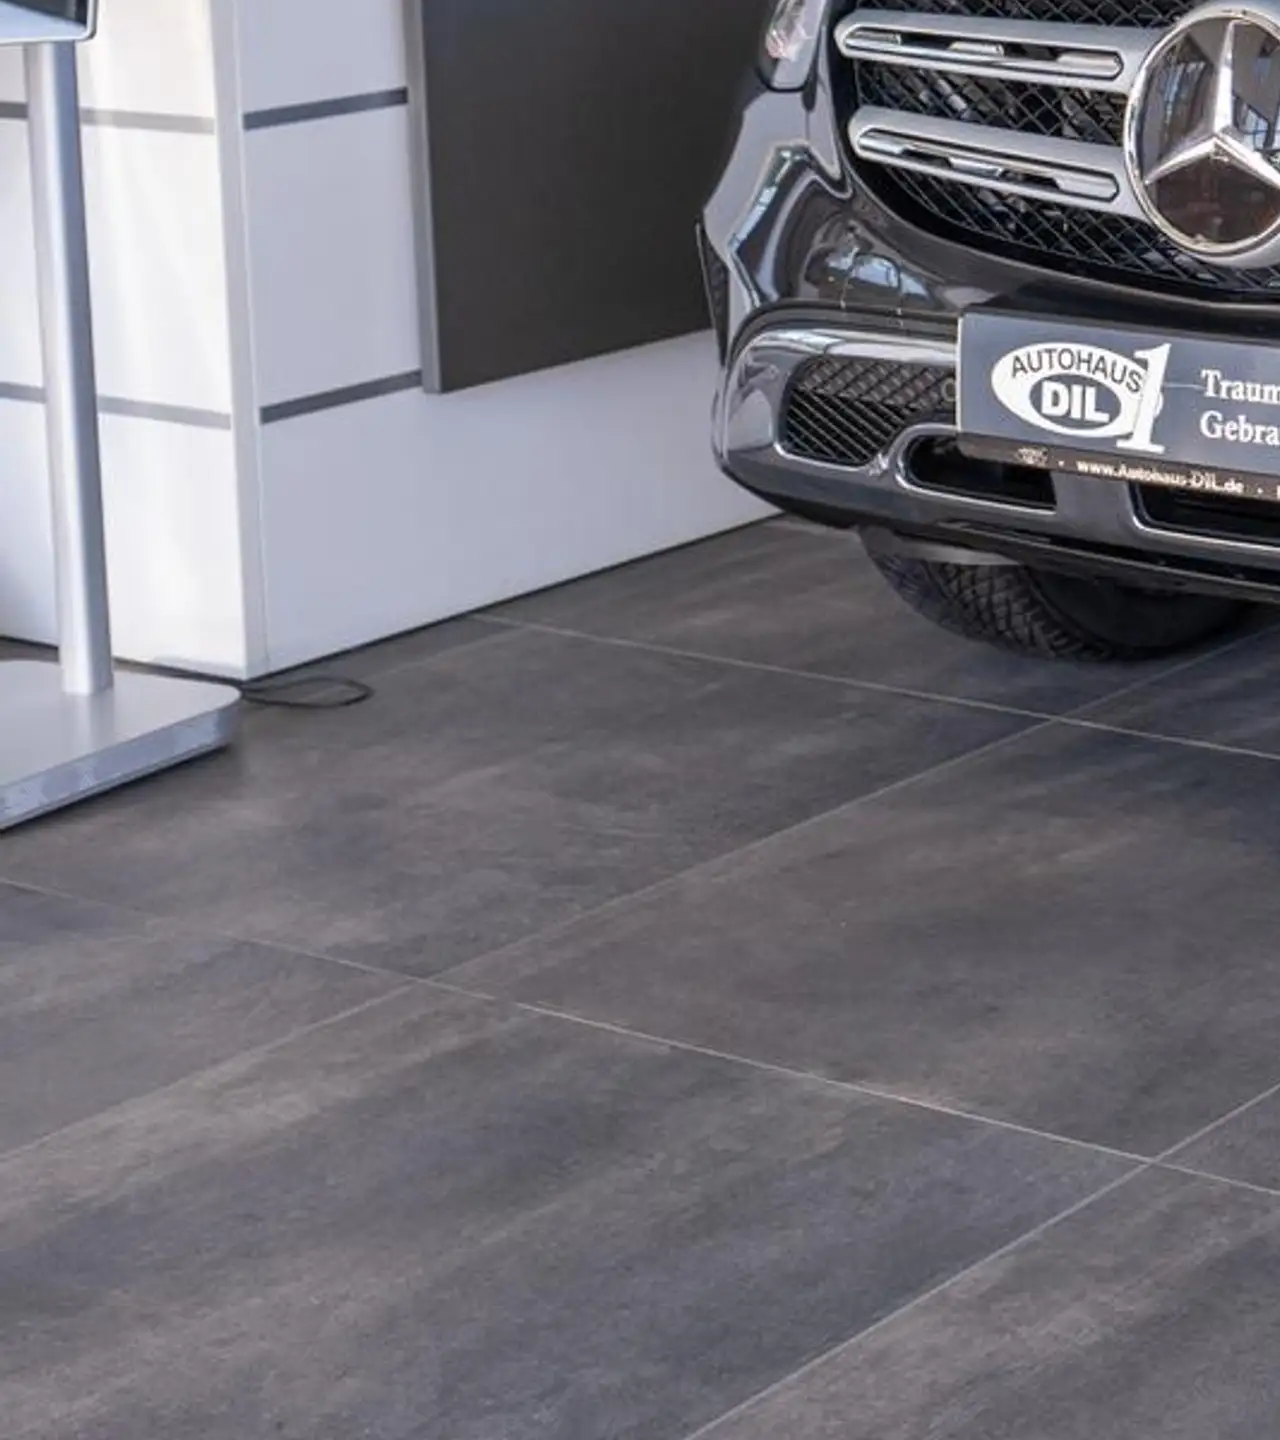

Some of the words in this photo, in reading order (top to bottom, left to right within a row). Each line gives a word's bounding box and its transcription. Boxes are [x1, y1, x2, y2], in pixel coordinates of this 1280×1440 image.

[1012, 348, 1143, 394] AUTOHAUS
[1040, 380, 1110, 423] DIL
[1115, 341, 1172, 455] 1
